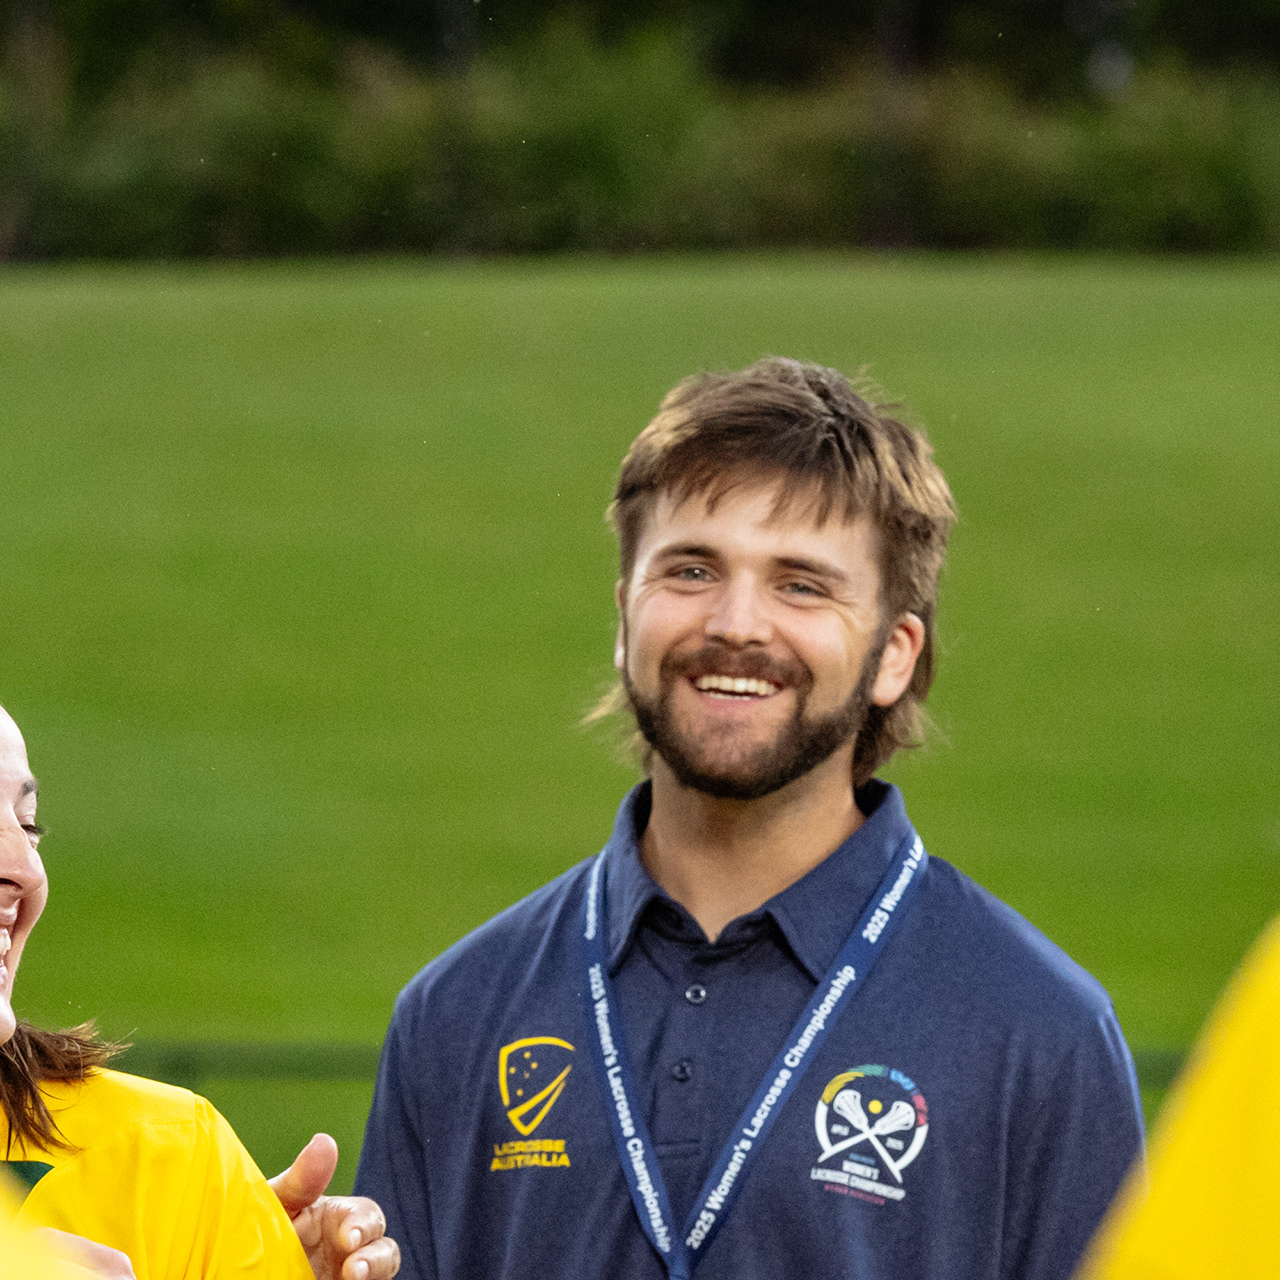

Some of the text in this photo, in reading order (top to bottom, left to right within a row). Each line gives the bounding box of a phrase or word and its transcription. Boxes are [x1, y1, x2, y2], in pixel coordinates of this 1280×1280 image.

[862, 908, 890, 944] 2025
[879, 858, 918, 912] Women's
[490, 1153, 571, 1173] AUSTRALIA
[594, 997, 619, 1067] Women's
[607, 1065, 635, 1138] Lacrosse
[626, 1137, 672, 1253] Championship
[685, 1209, 716, 1250] 2025
[705, 1138, 753, 1211] Women's
[742, 1068, 792, 1138] Lacrosse
[783, 964, 857, 1068] Championship
